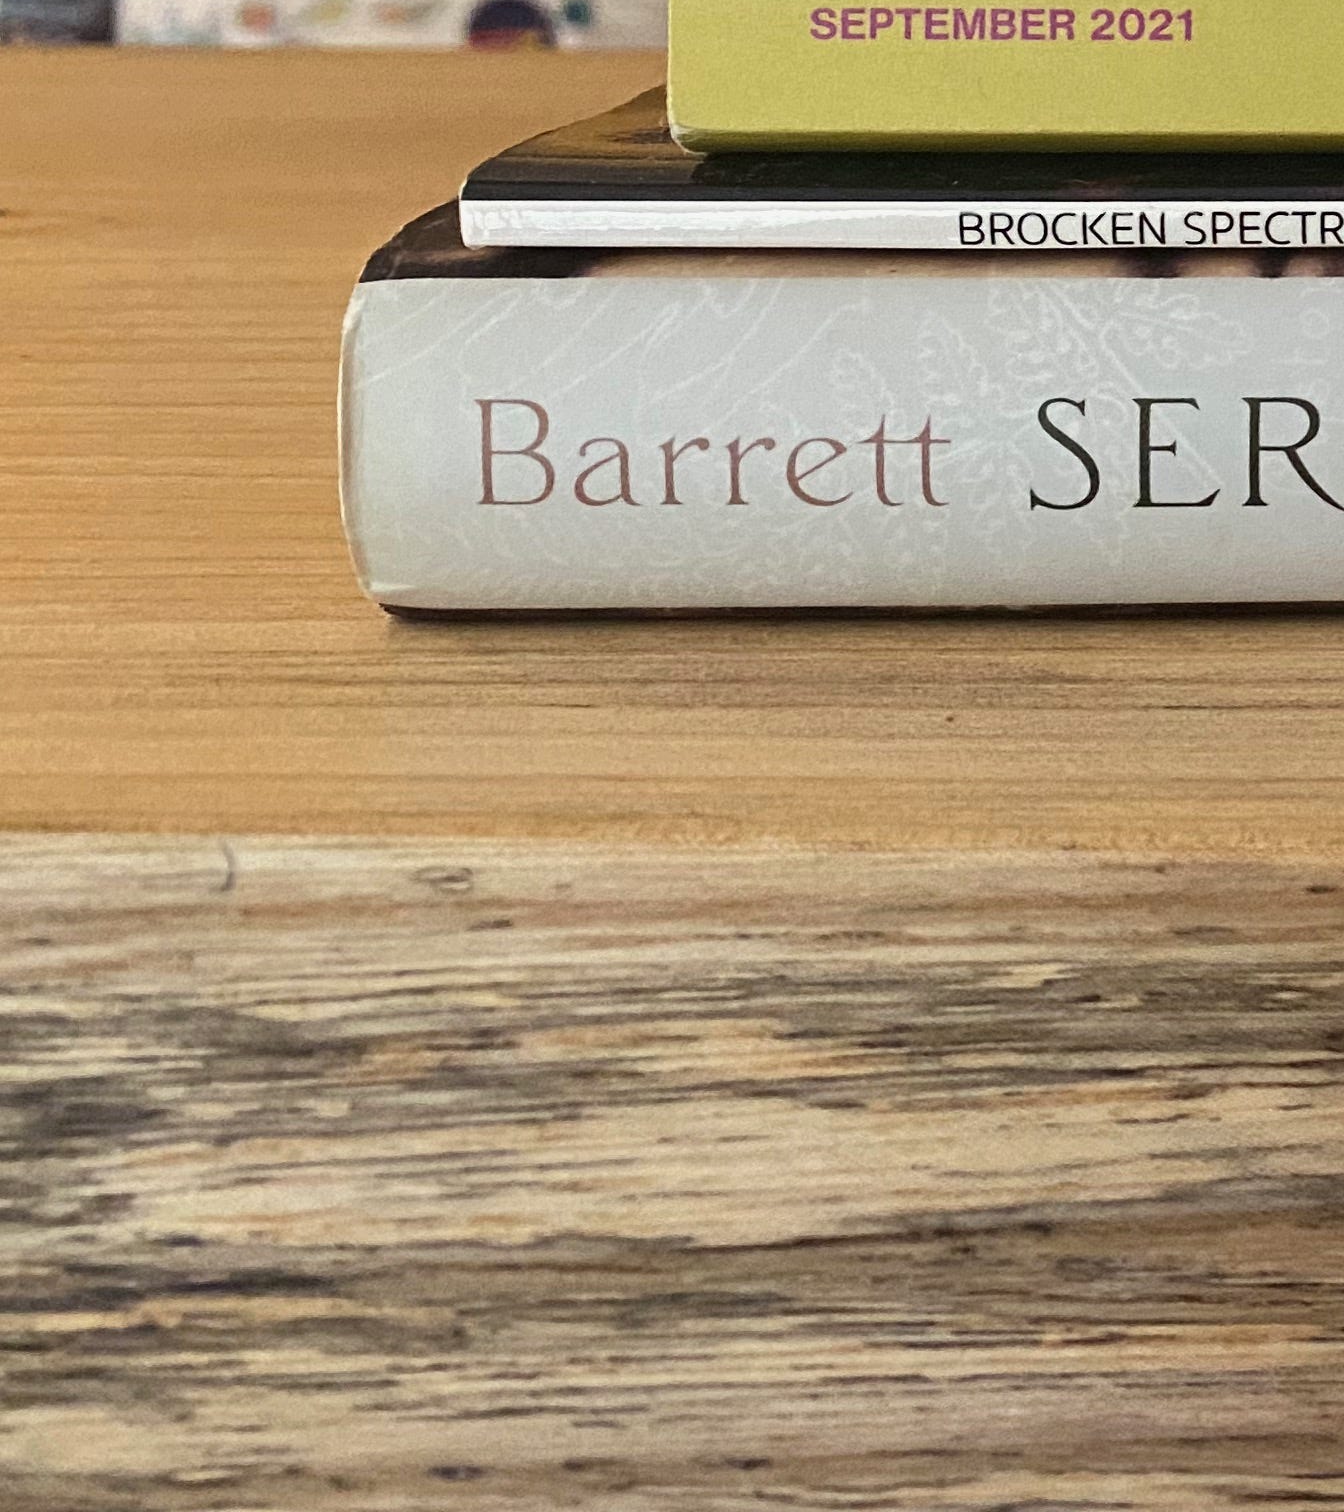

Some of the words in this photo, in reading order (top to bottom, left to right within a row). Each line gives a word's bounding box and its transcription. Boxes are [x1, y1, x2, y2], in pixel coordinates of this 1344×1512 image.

[810, 7, 1076, 41] SEPTEMBER
[1090, 7, 1193, 42] 2021
[958, 211, 1167, 245] BROCKEN
[474, 398, 952, 508] Barrett
